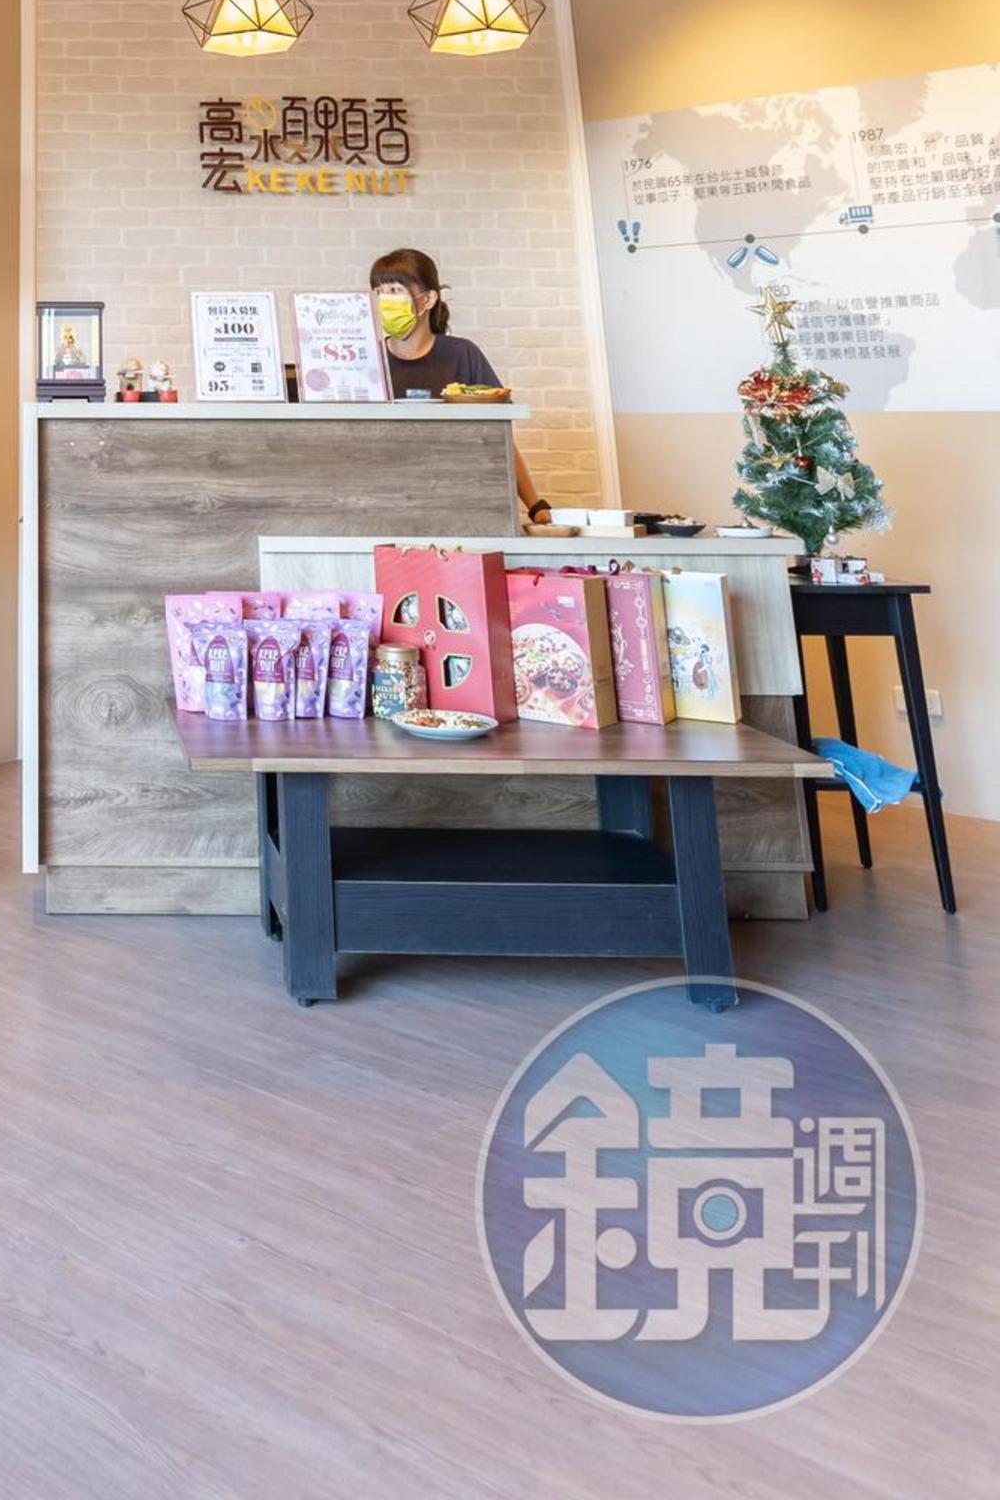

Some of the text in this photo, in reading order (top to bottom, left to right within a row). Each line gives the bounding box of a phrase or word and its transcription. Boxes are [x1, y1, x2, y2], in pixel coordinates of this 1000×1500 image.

[852, 128, 884, 142] 1987
[624, 157, 653, 172] 1976
[346, 167, 411, 194] NUT
